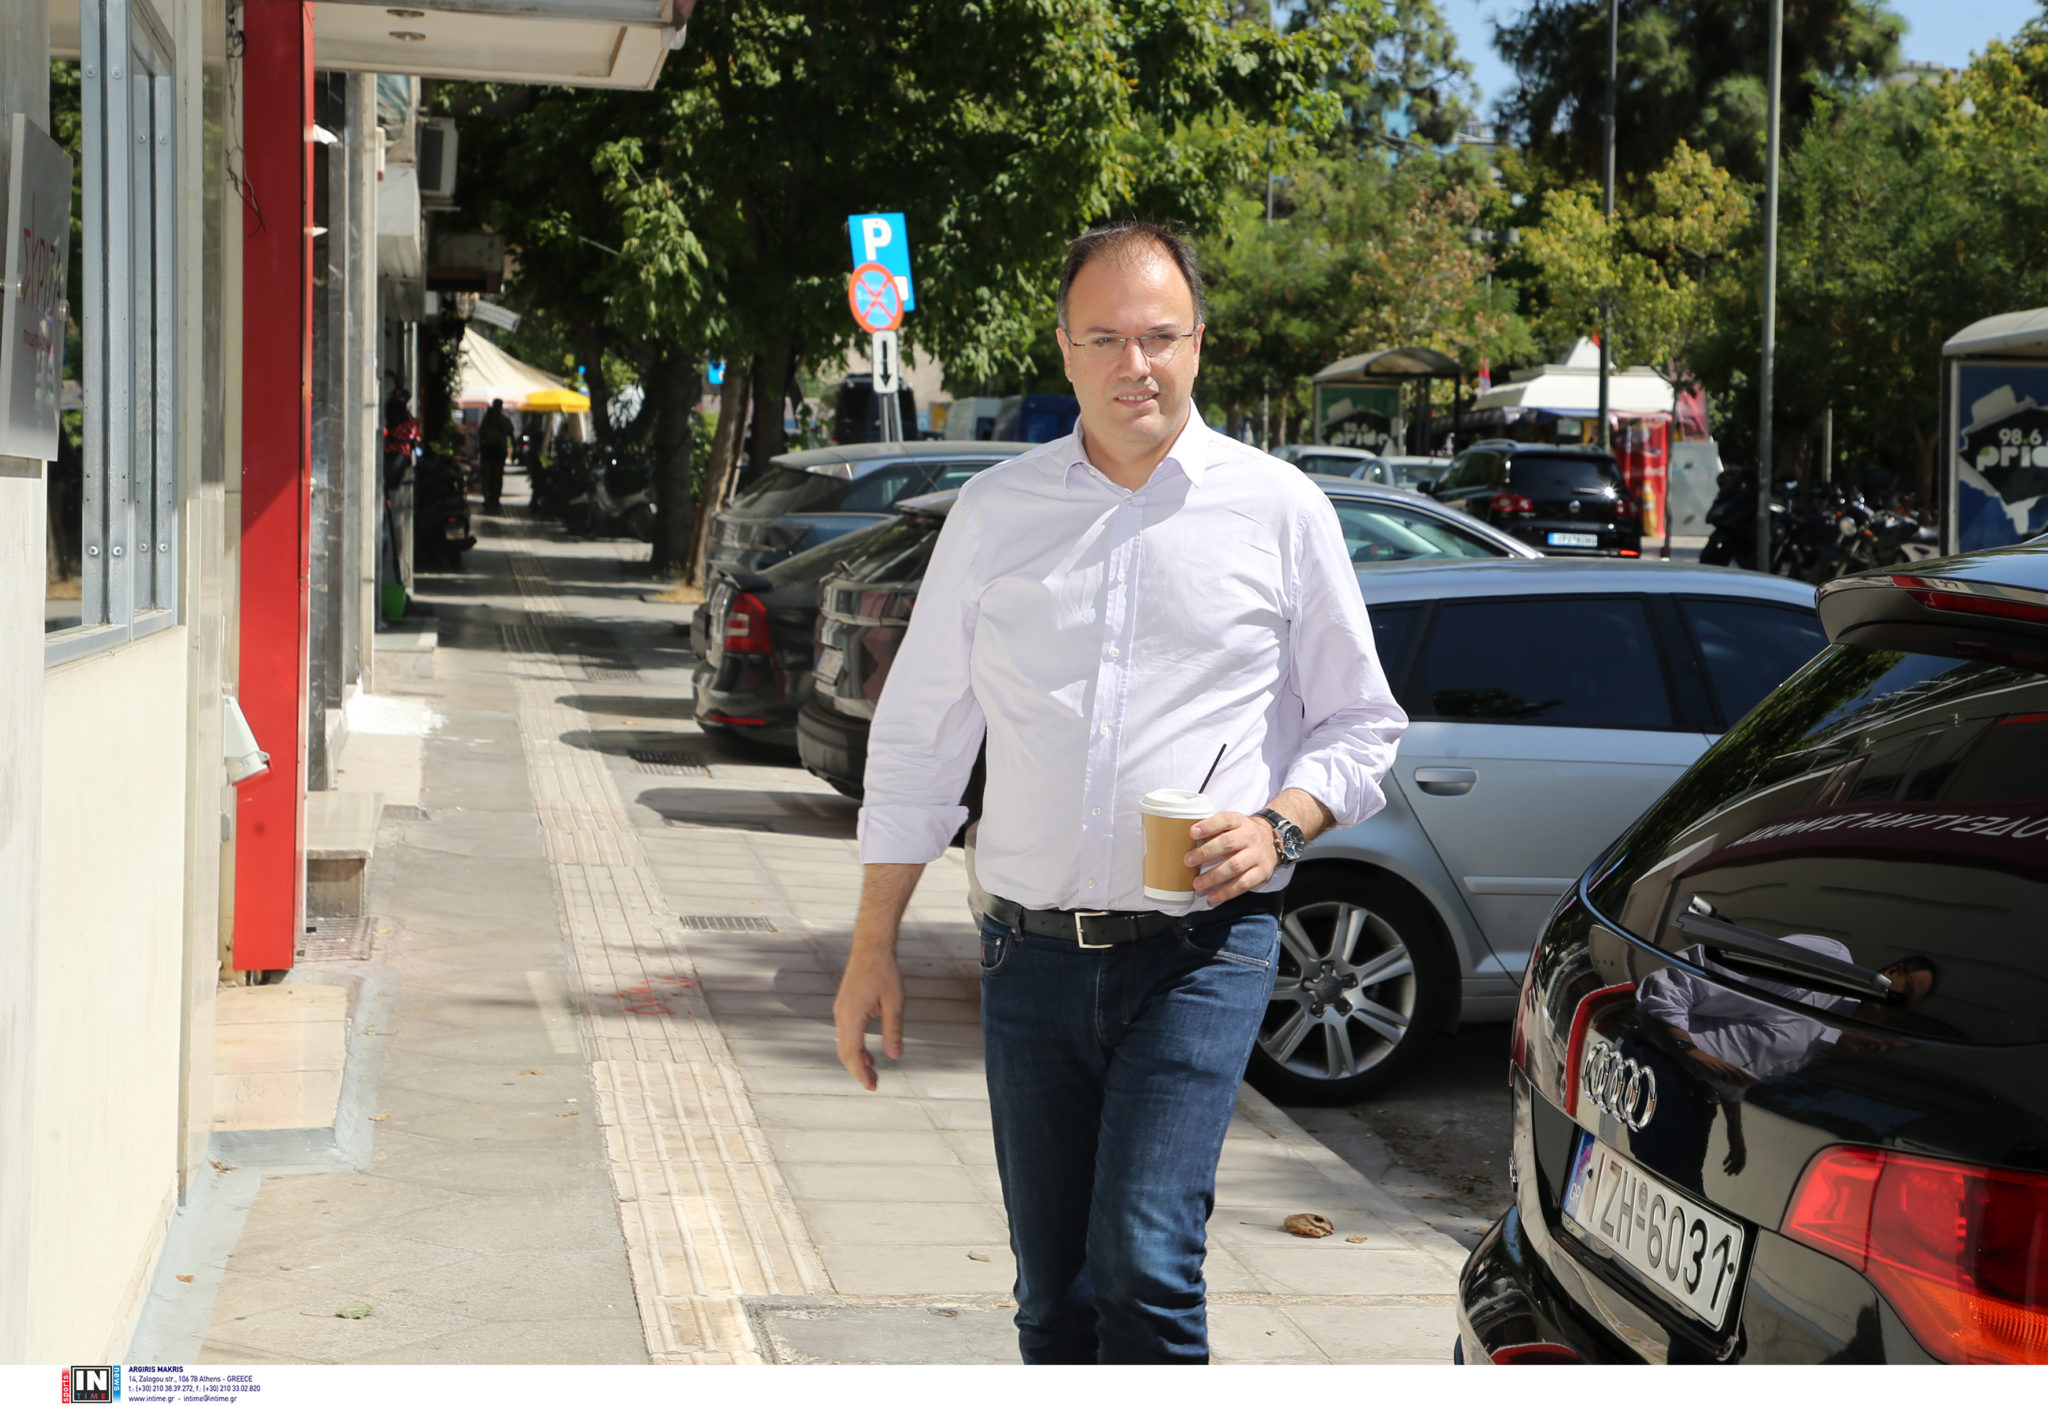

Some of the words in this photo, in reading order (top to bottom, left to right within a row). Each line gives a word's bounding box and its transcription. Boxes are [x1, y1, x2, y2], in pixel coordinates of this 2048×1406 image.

[862, 218, 892, 261] P
[1998, 428, 2042, 445] 98.6
[1570, 1182, 1583, 1205] GR
